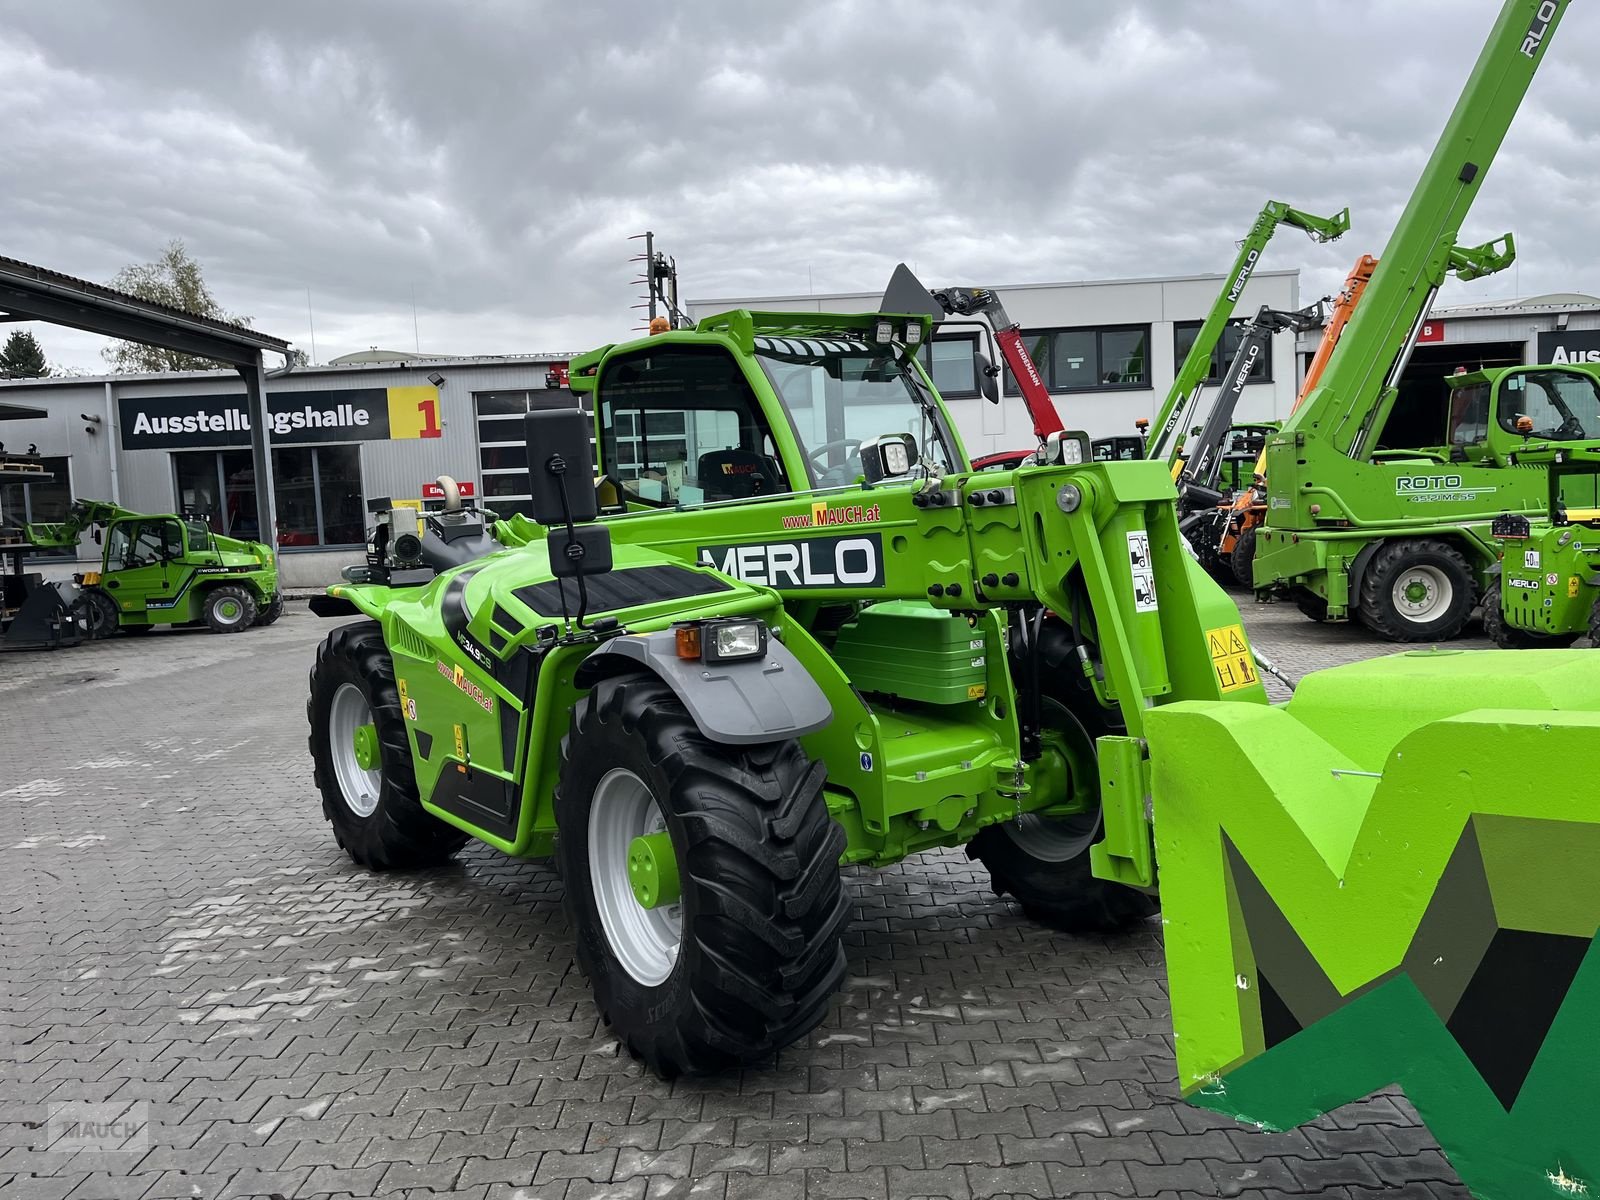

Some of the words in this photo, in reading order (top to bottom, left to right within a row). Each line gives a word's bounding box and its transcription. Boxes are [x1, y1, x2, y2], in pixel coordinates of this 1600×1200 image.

[1520, 0, 1557, 58] RLO
[1227, 250, 1258, 302] MERLO
[1423, 326, 1433, 336] B
[1014, 339, 1041, 387] WEIDEMANN
[1232, 345, 1259, 393] MERLO
[417, 400, 442, 438] 1
[460, 485, 467, 493] A
[1396, 475, 1461, 490] ROTO
[782, 503, 881, 530] www.MAUCH.at
[701, 538, 876, 586] MERLO
[1508, 579, 1539, 589] MERLO
[436, 660, 494, 714] www.MAUCH.at
